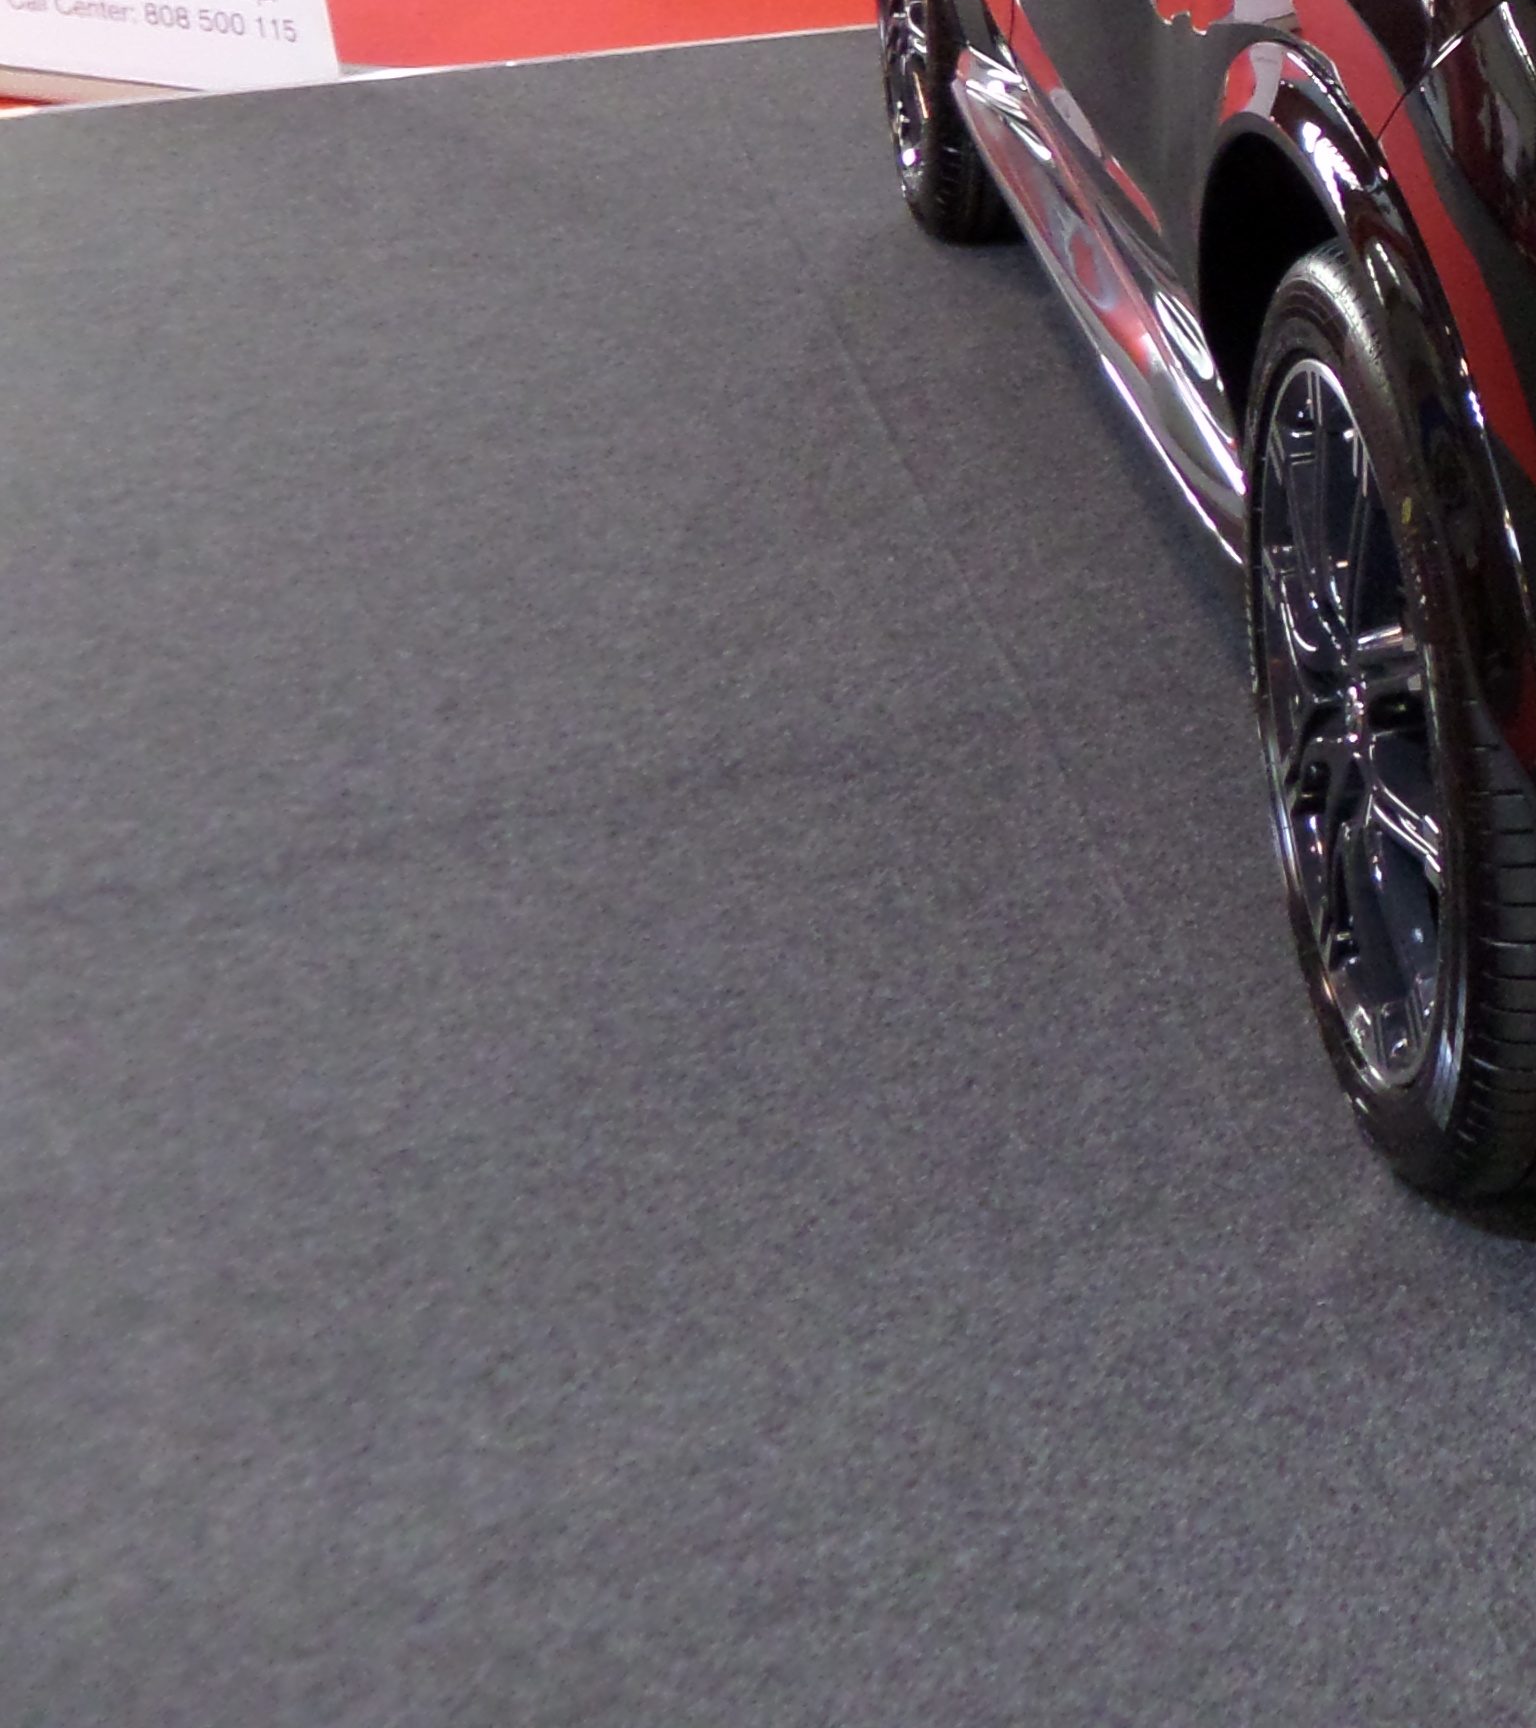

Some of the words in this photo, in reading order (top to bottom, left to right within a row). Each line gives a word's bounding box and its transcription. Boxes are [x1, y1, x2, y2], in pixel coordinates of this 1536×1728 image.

[145, 3, 192, 30] 808
[199, 9, 246, 36] 500
[256, 17, 298, 43] 115
